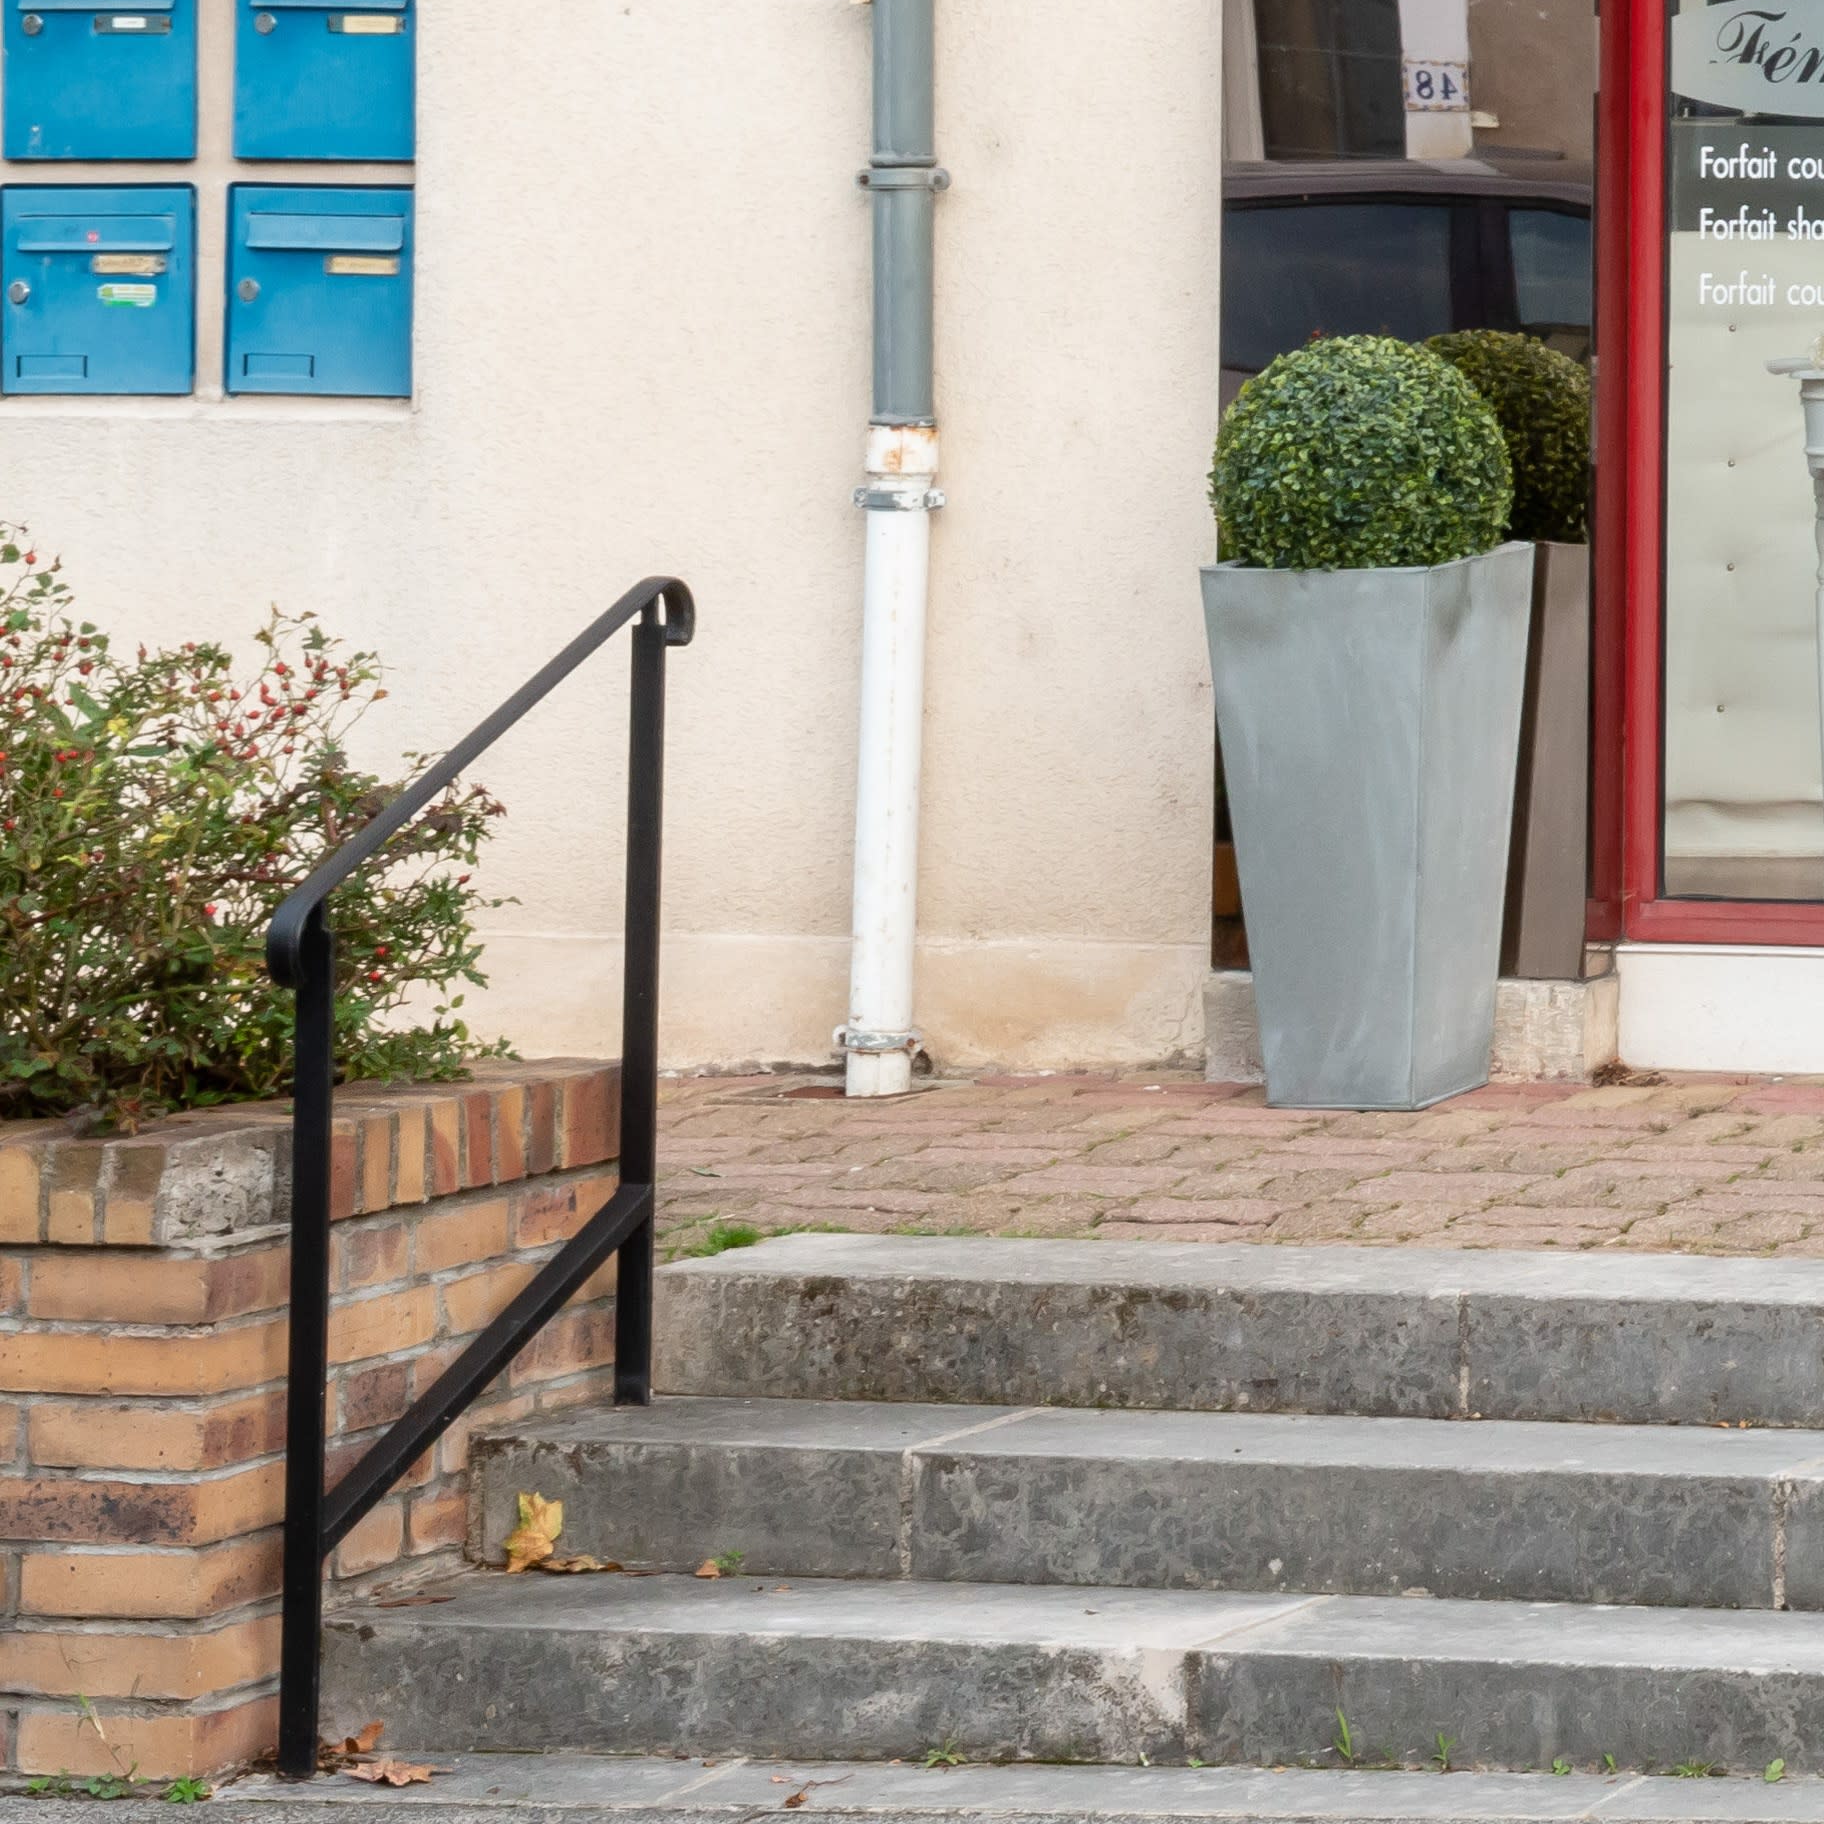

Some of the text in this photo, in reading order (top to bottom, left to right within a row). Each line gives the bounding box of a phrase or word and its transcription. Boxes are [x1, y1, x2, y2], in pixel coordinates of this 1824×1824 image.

[1700, 143, 1776, 181] Forfait
[1700, 206, 1777, 243] Forfait
[1700, 271, 1776, 307] Forfait
